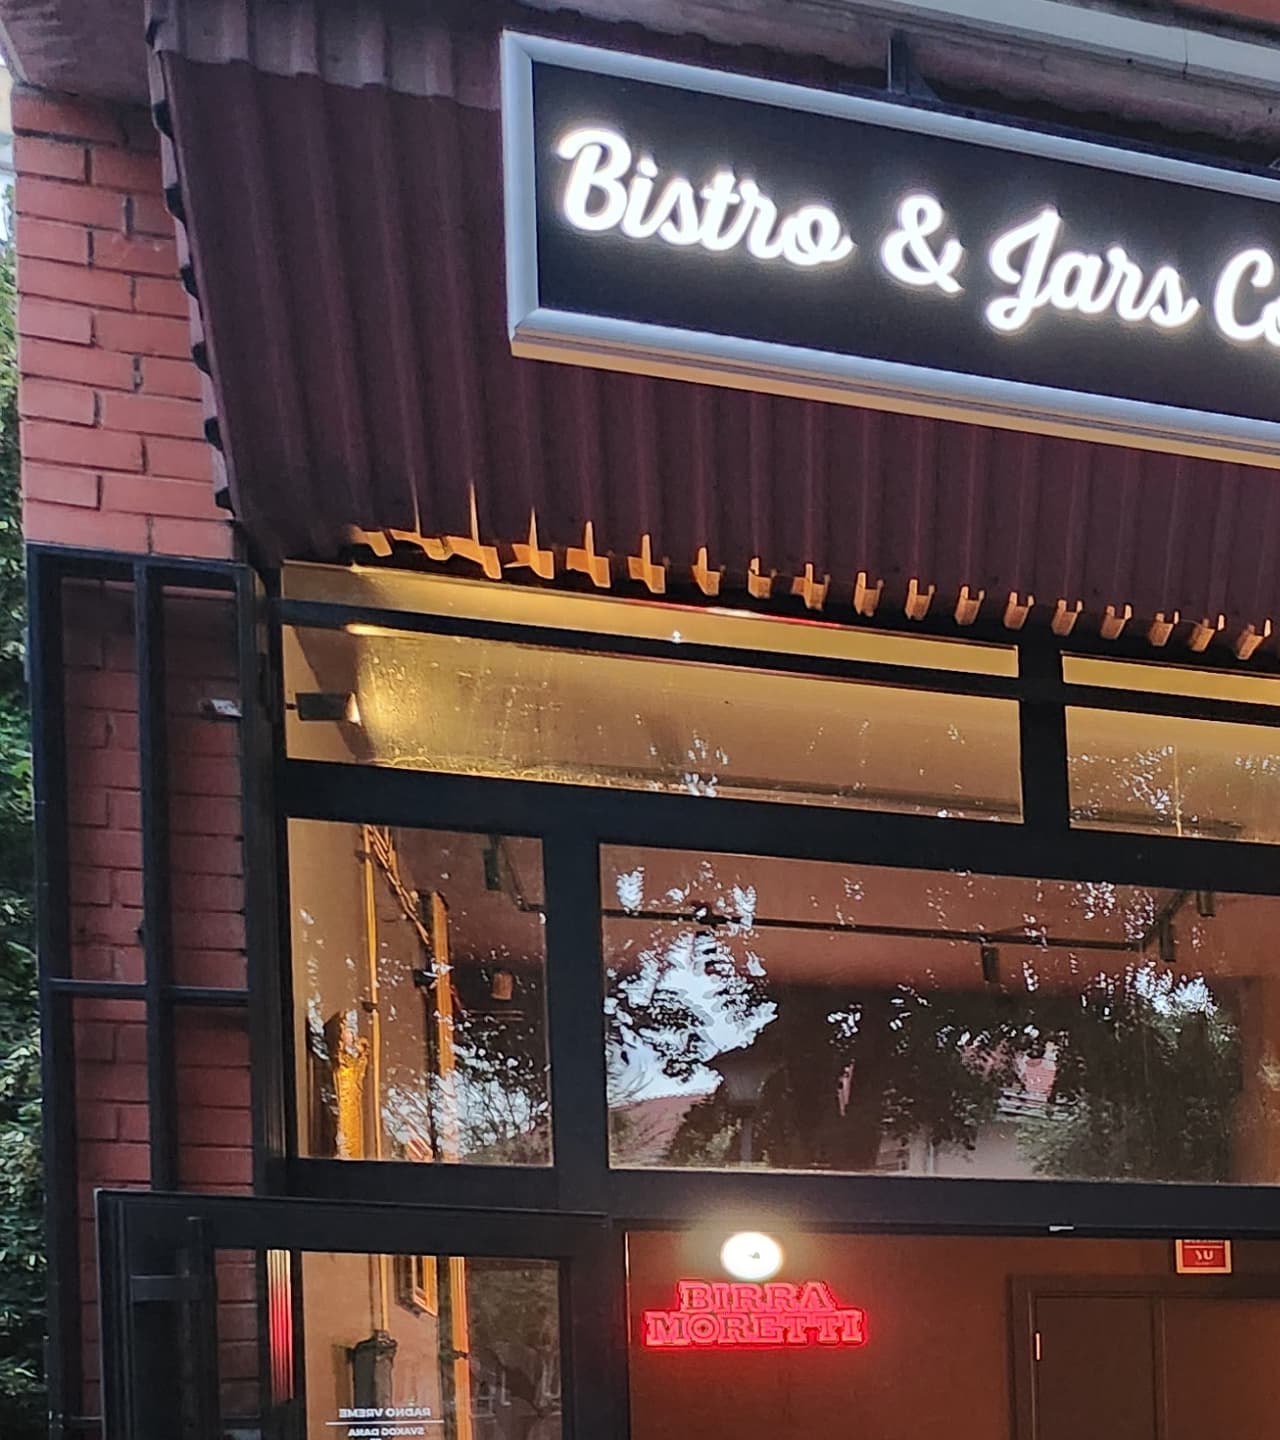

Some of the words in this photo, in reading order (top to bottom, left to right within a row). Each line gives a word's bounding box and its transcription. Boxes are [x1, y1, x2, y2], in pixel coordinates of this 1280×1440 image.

[555, 126, 856, 268] Bistro
[880, 194, 965, 295] &
[984, 207, 1202, 333] Jars
[678, 1279, 837, 1313] BIRRA
[644, 1310, 866, 1346] MORETTI
